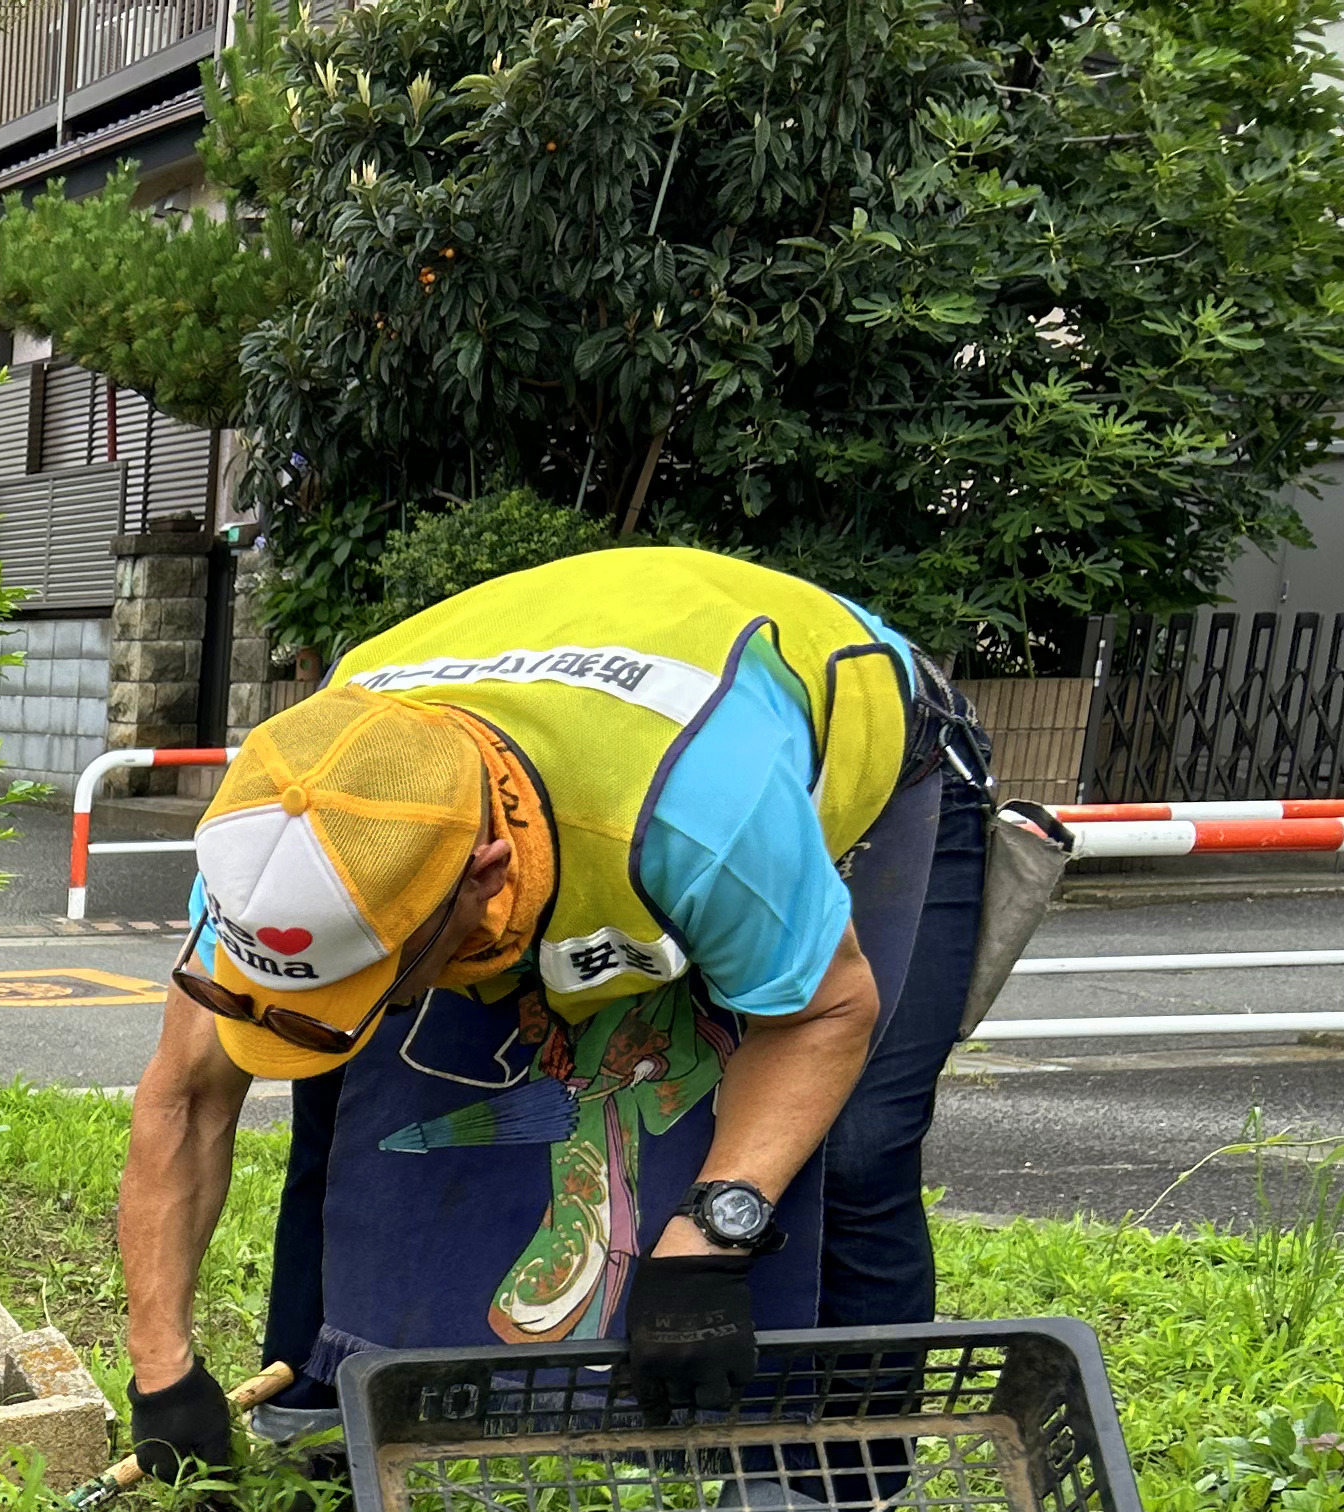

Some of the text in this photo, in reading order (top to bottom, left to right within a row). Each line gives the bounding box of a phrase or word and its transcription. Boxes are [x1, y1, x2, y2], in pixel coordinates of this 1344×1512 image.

[345, 652, 654, 692] 防犯パトロール
[217, 930, 320, 979] ama
